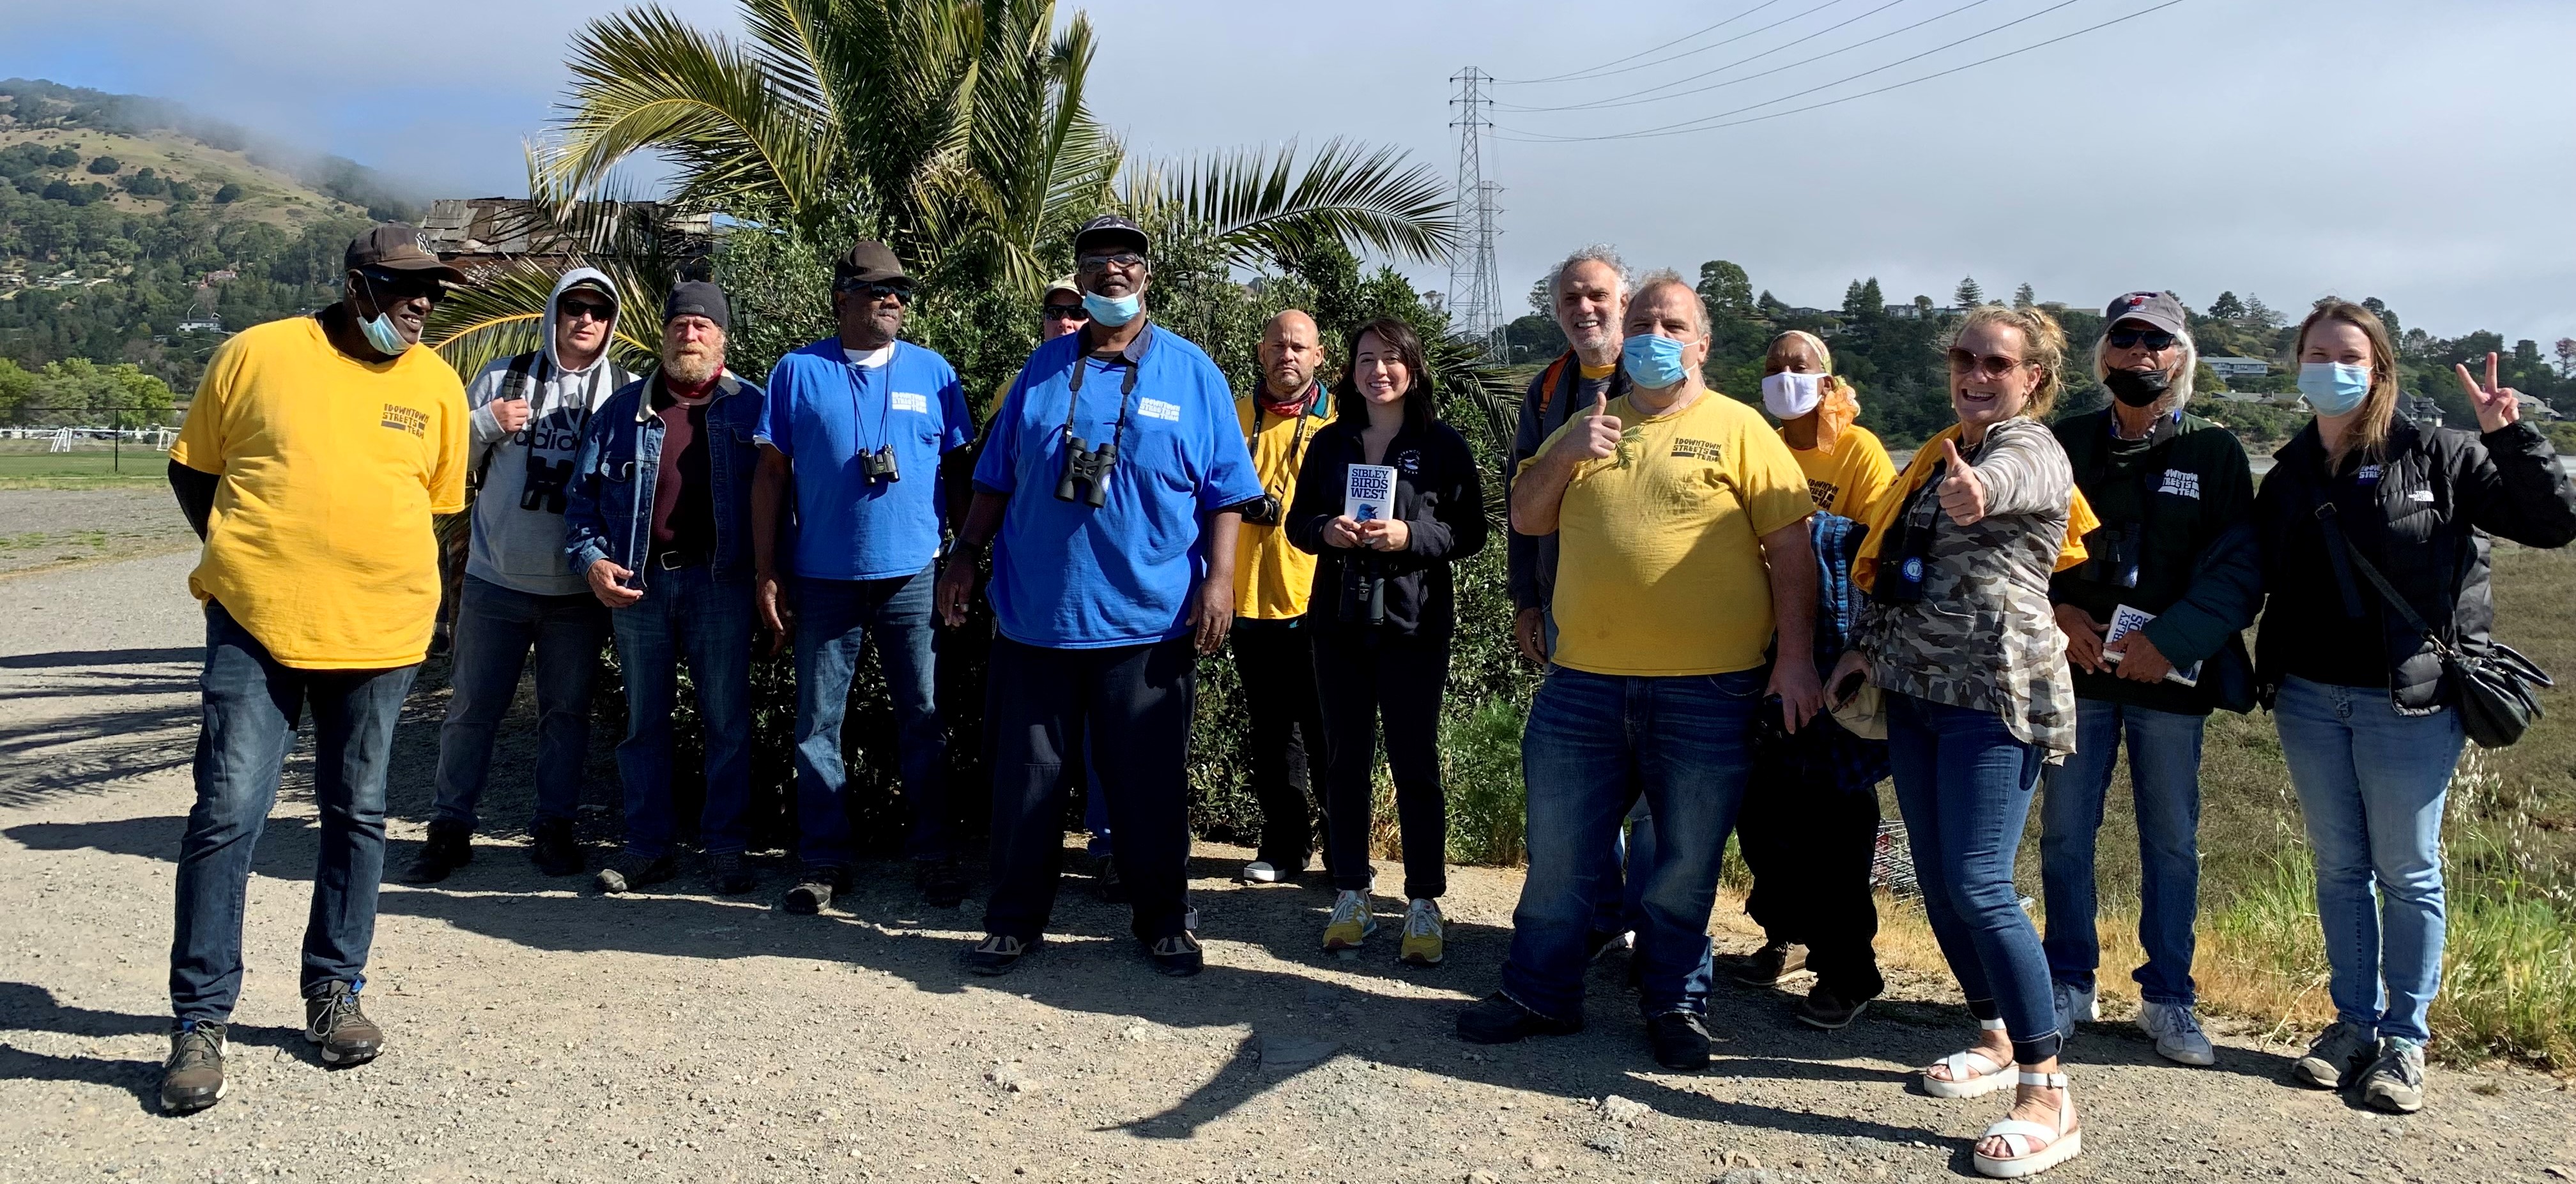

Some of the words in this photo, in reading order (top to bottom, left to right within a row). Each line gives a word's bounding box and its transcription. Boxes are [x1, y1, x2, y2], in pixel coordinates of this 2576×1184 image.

[382, 412, 418, 427] STREETS
[388, 404, 430, 423] DOWNTOWN
[407, 425, 424, 439] TEAM
[1672, 444, 1710, 455] STREETS
[1678, 438, 1722, 450] DOWNTOWN
[1696, 453, 1719, 462] TEAM
[1351, 468, 1389, 478] SIBLEY
[1351, 477, 1388, 489] BIRDS
[1351, 487, 1388, 499] WEST
[2178, 488, 2200, 500] TEAM
